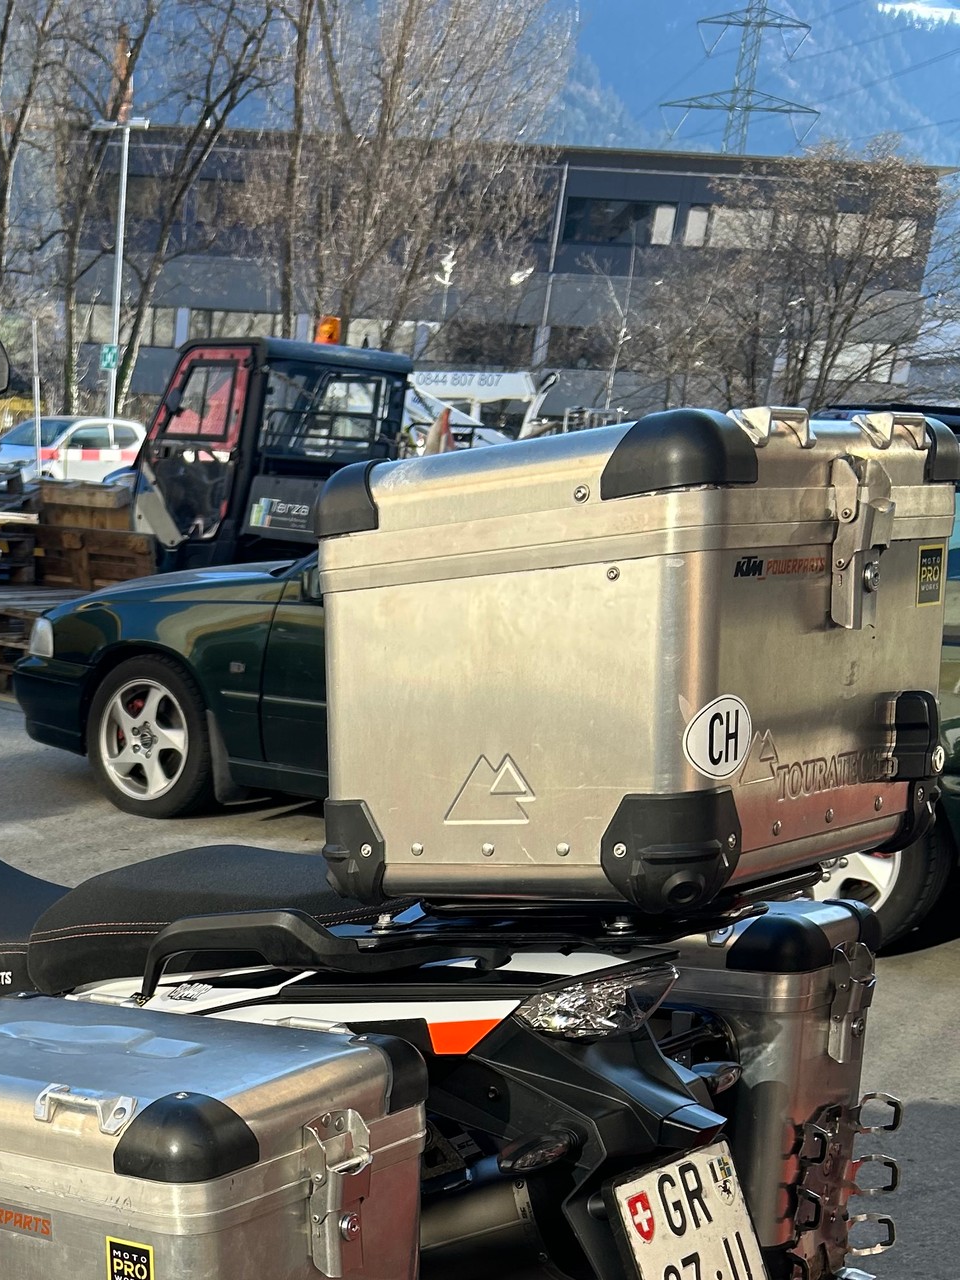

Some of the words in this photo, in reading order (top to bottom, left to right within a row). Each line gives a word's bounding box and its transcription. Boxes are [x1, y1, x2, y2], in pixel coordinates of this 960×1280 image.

[416, 373, 447, 386] 0844
[451, 373, 475, 386] 807
[478, 374, 503, 387] 807
[271, 498, 310, 515] Terza
[734, 556, 764, 577] KTM
[766, 557, 826, 575] POWERPARTS
[921, 556, 941, 565] MOTO
[920, 565, 940, 582] PRO
[920, 582, 940, 591] WORKS
[708, 709, 740, 765] CH
[657, 1162, 714, 1237] GR
[113, 1249, 147, 1263] MOTO
[113, 1257, 147, 1280] PRO
